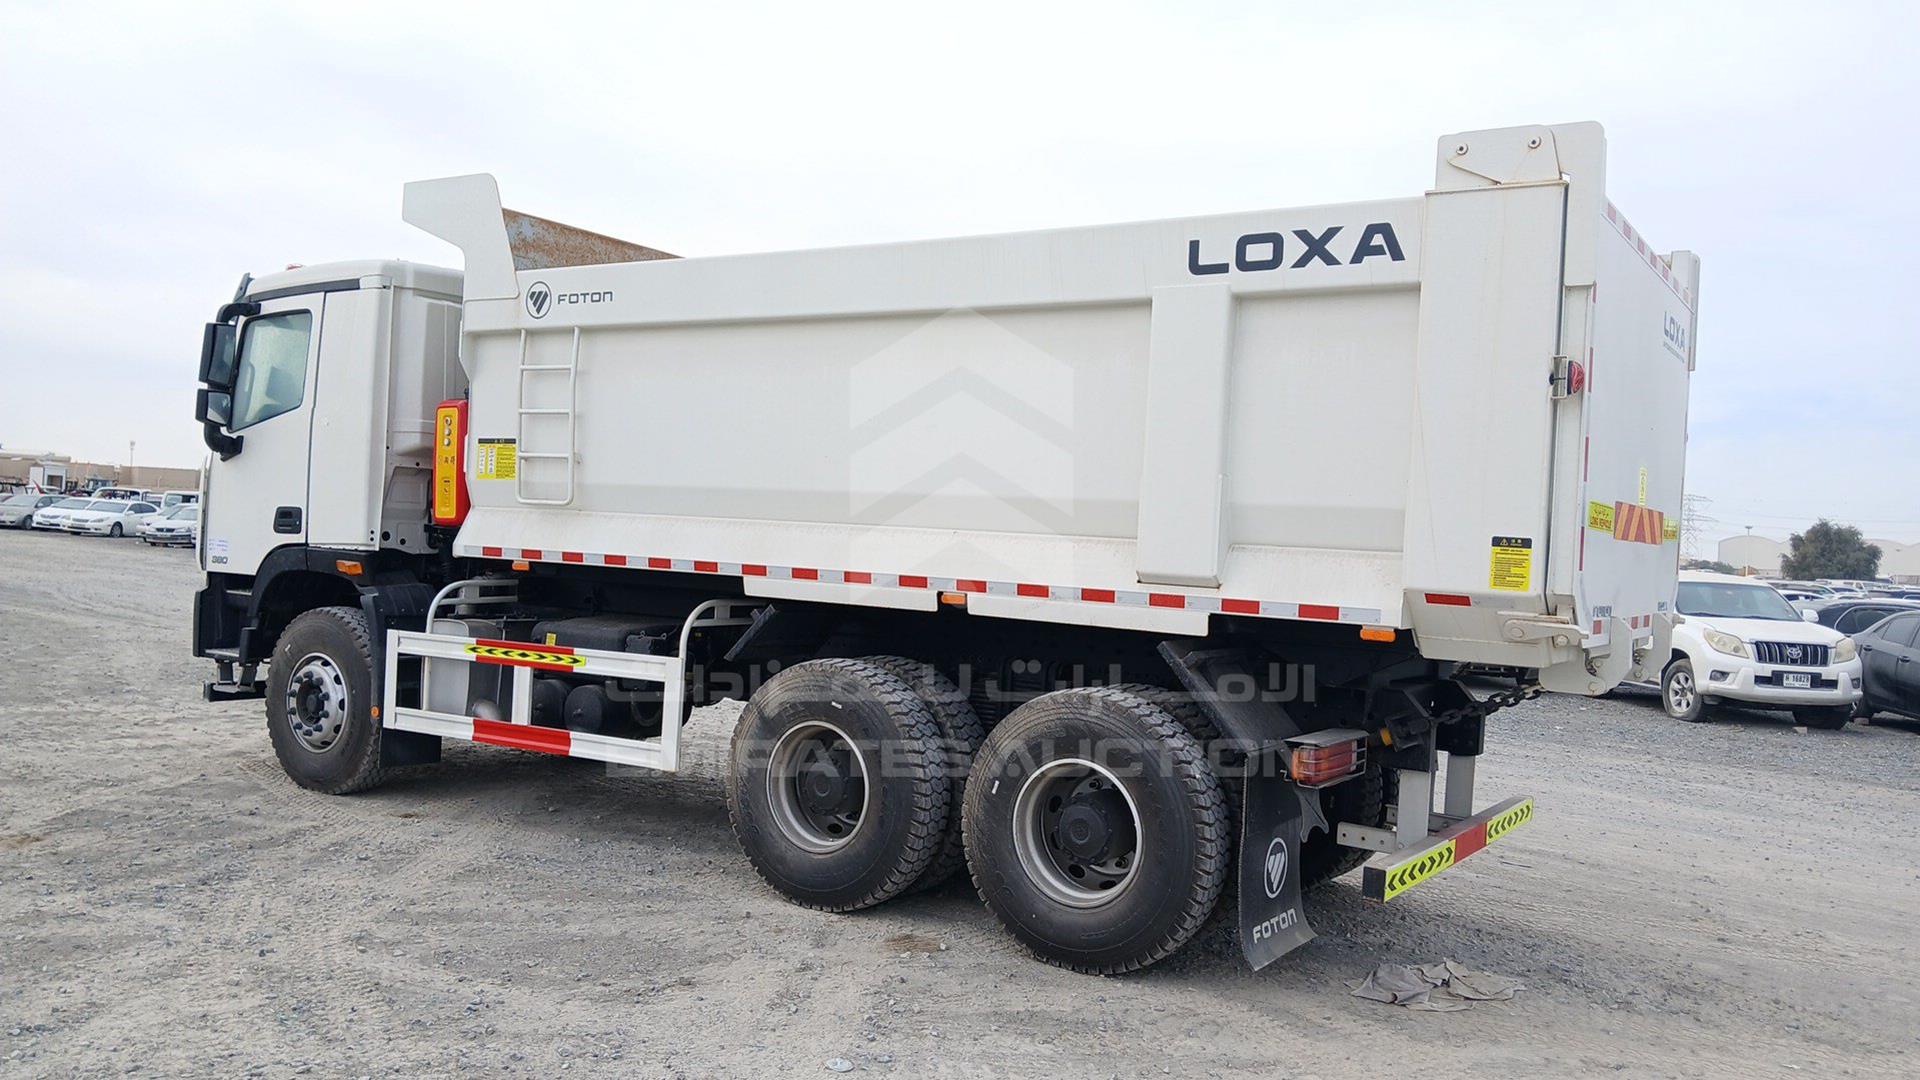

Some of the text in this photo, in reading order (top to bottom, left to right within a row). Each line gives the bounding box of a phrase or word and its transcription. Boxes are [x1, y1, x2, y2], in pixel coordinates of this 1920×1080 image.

[1188, 222, 1406, 276] LOXA
[557, 291, 613, 305] FOTON
[1664, 311, 1685, 352] LOXA
[1252, 908, 1298, 944] FOTON
